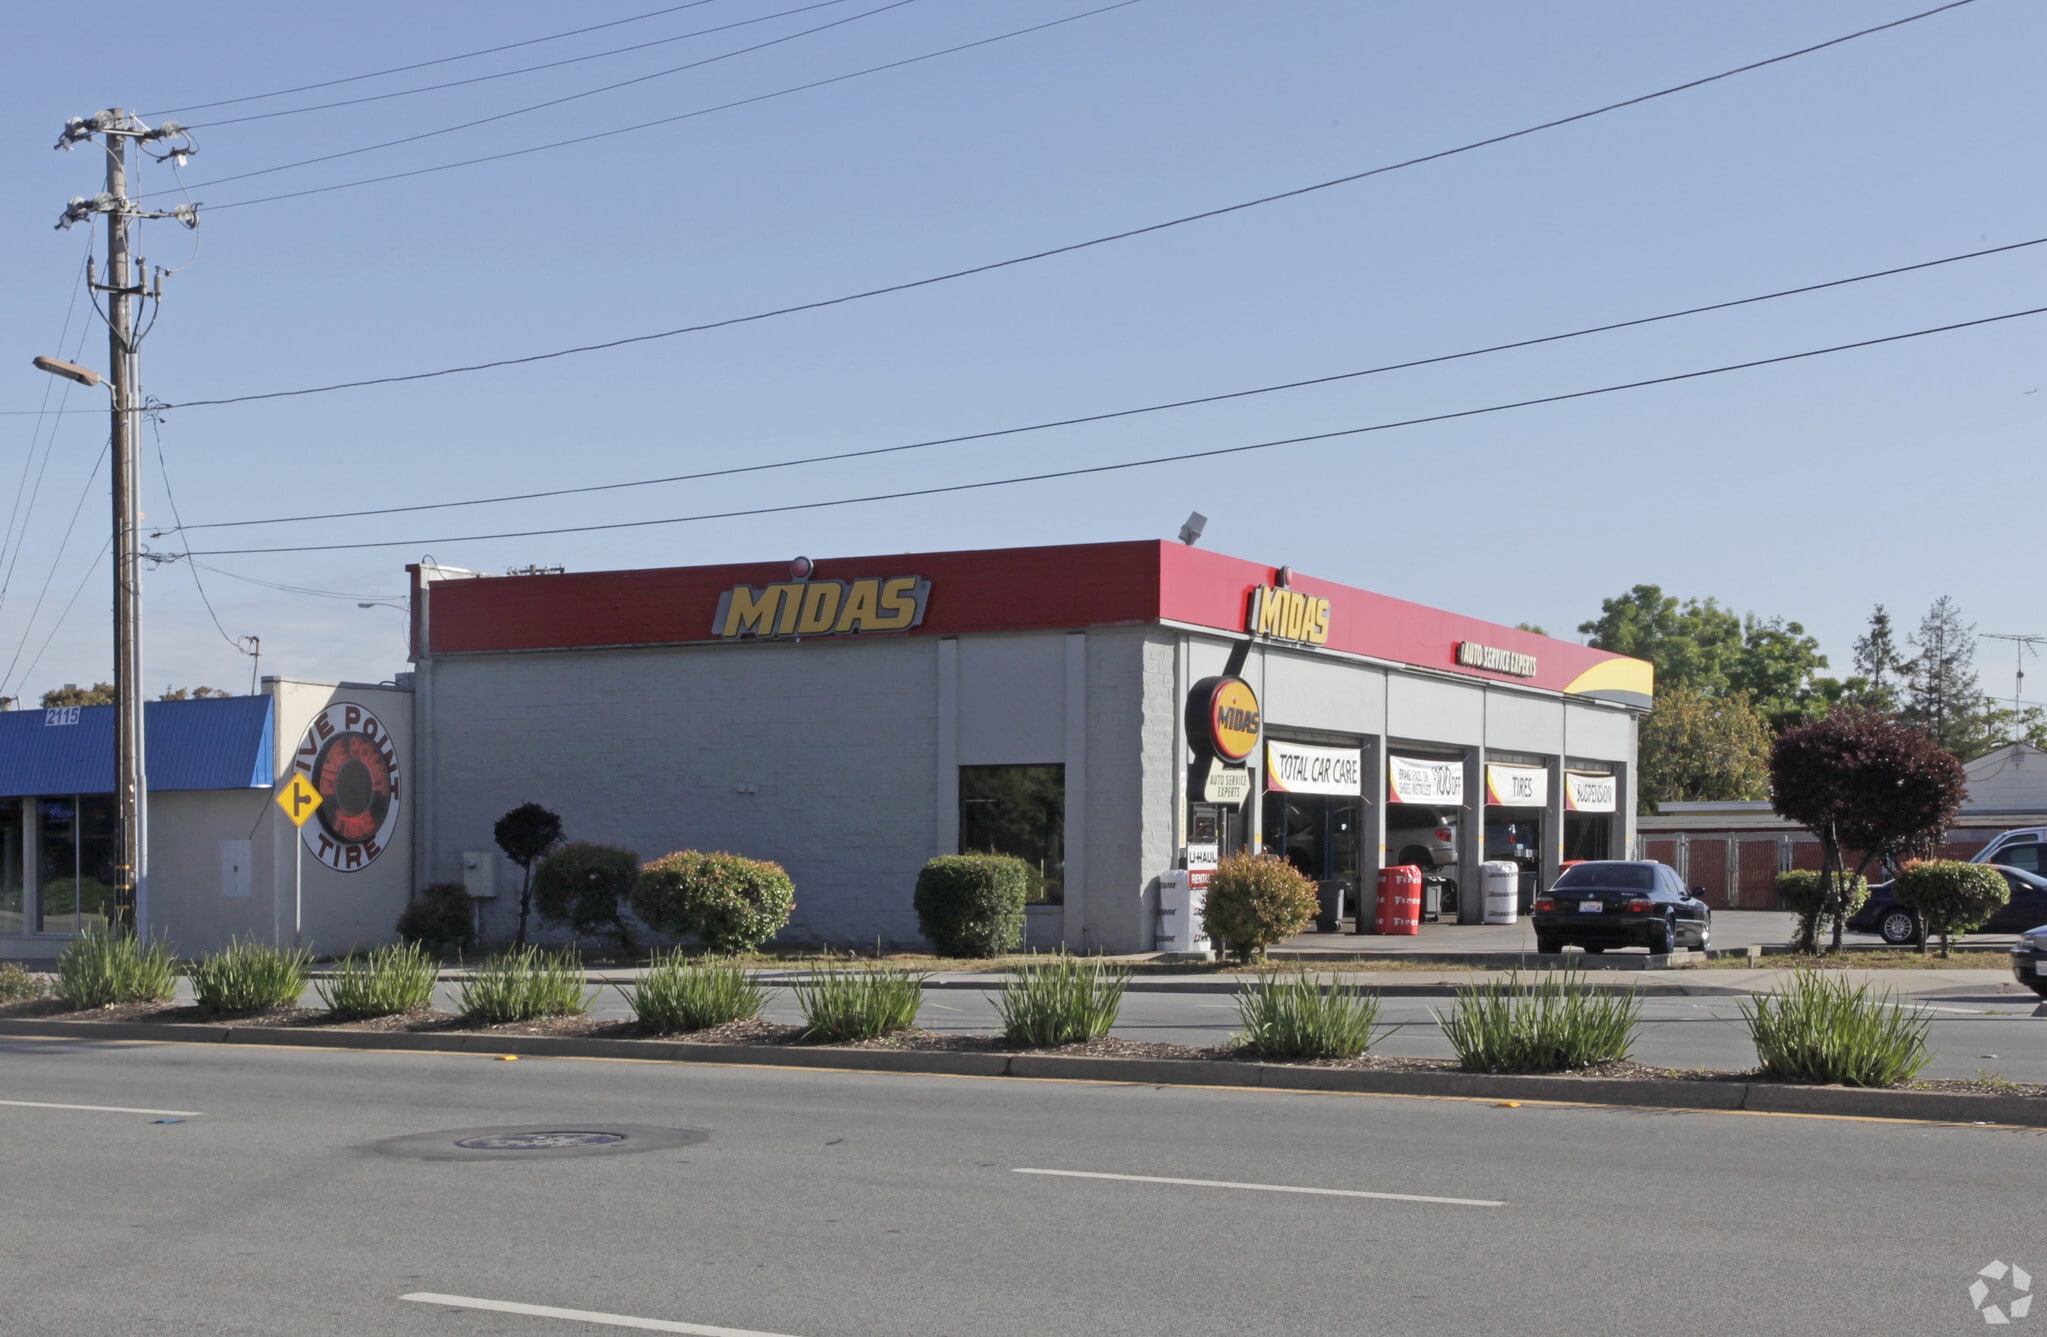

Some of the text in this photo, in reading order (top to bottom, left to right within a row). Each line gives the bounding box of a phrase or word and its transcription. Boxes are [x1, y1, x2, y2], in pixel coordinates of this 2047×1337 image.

[722, 576, 918, 637] MIDAS
[1257, 586, 1330, 645] MIDAS
[1463, 641, 1537, 677] AUTO SERVICE EXPERTS
[47, 707, 79, 725] 2115
[1217, 704, 1260, 734] MIDAS
[296, 706, 399, 800] IVE POINT
[1210, 774, 1247, 787] AUTO SERVICE
[1280, 754, 1358, 785] TOTAL CAR CARE
[1217, 786, 1241, 798] EXPERTS
[1512, 776, 1533, 798] TIRES
[1577, 783, 1612, 804] SUSPENSION
[318, 833, 381, 869] TIRE
[1192, 873, 1210, 885] RENTA
